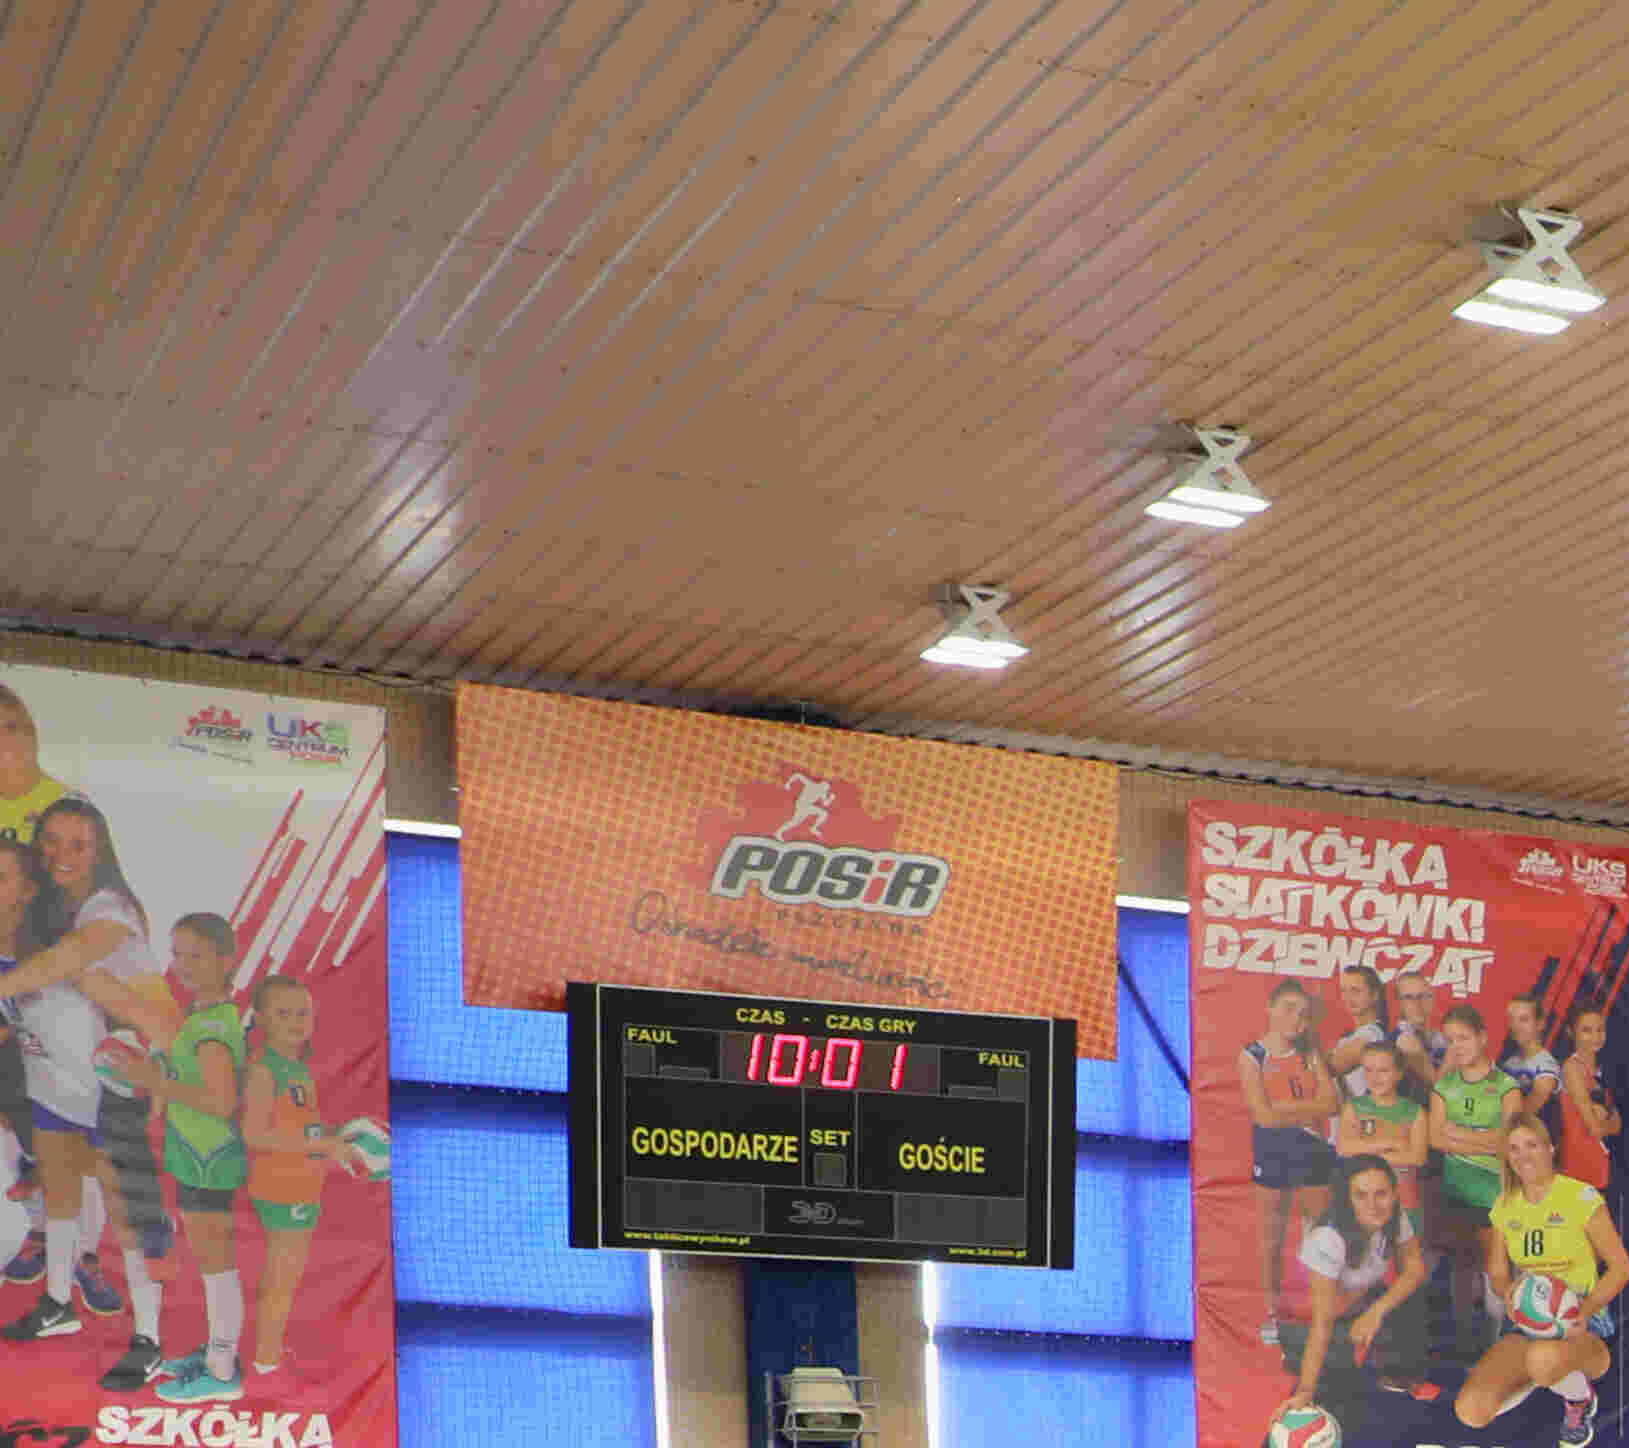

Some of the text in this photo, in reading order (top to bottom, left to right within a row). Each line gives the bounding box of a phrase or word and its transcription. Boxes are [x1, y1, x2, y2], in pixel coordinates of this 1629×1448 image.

[1202, 821, 1450, 890] SZKÓŁKA
[1202, 872, 1486, 945] SIATKÓWKI
[1202, 922, 1496, 999] DZIEWCZĄT
[627, 1028, 679, 1046] FAUL
[736, 1007, 918, 1035] CZAS CZAS GRY
[746, 1033, 908, 1091] 10:01
[978, 1051, 1025, 1068] FAUL
[631, 1126, 800, 1164] GOSPODARZE
[809, 1129, 851, 1147] SET
[898, 1135, 986, 1174] GOŚCIE
[1522, 1228, 1545, 1258] 18
